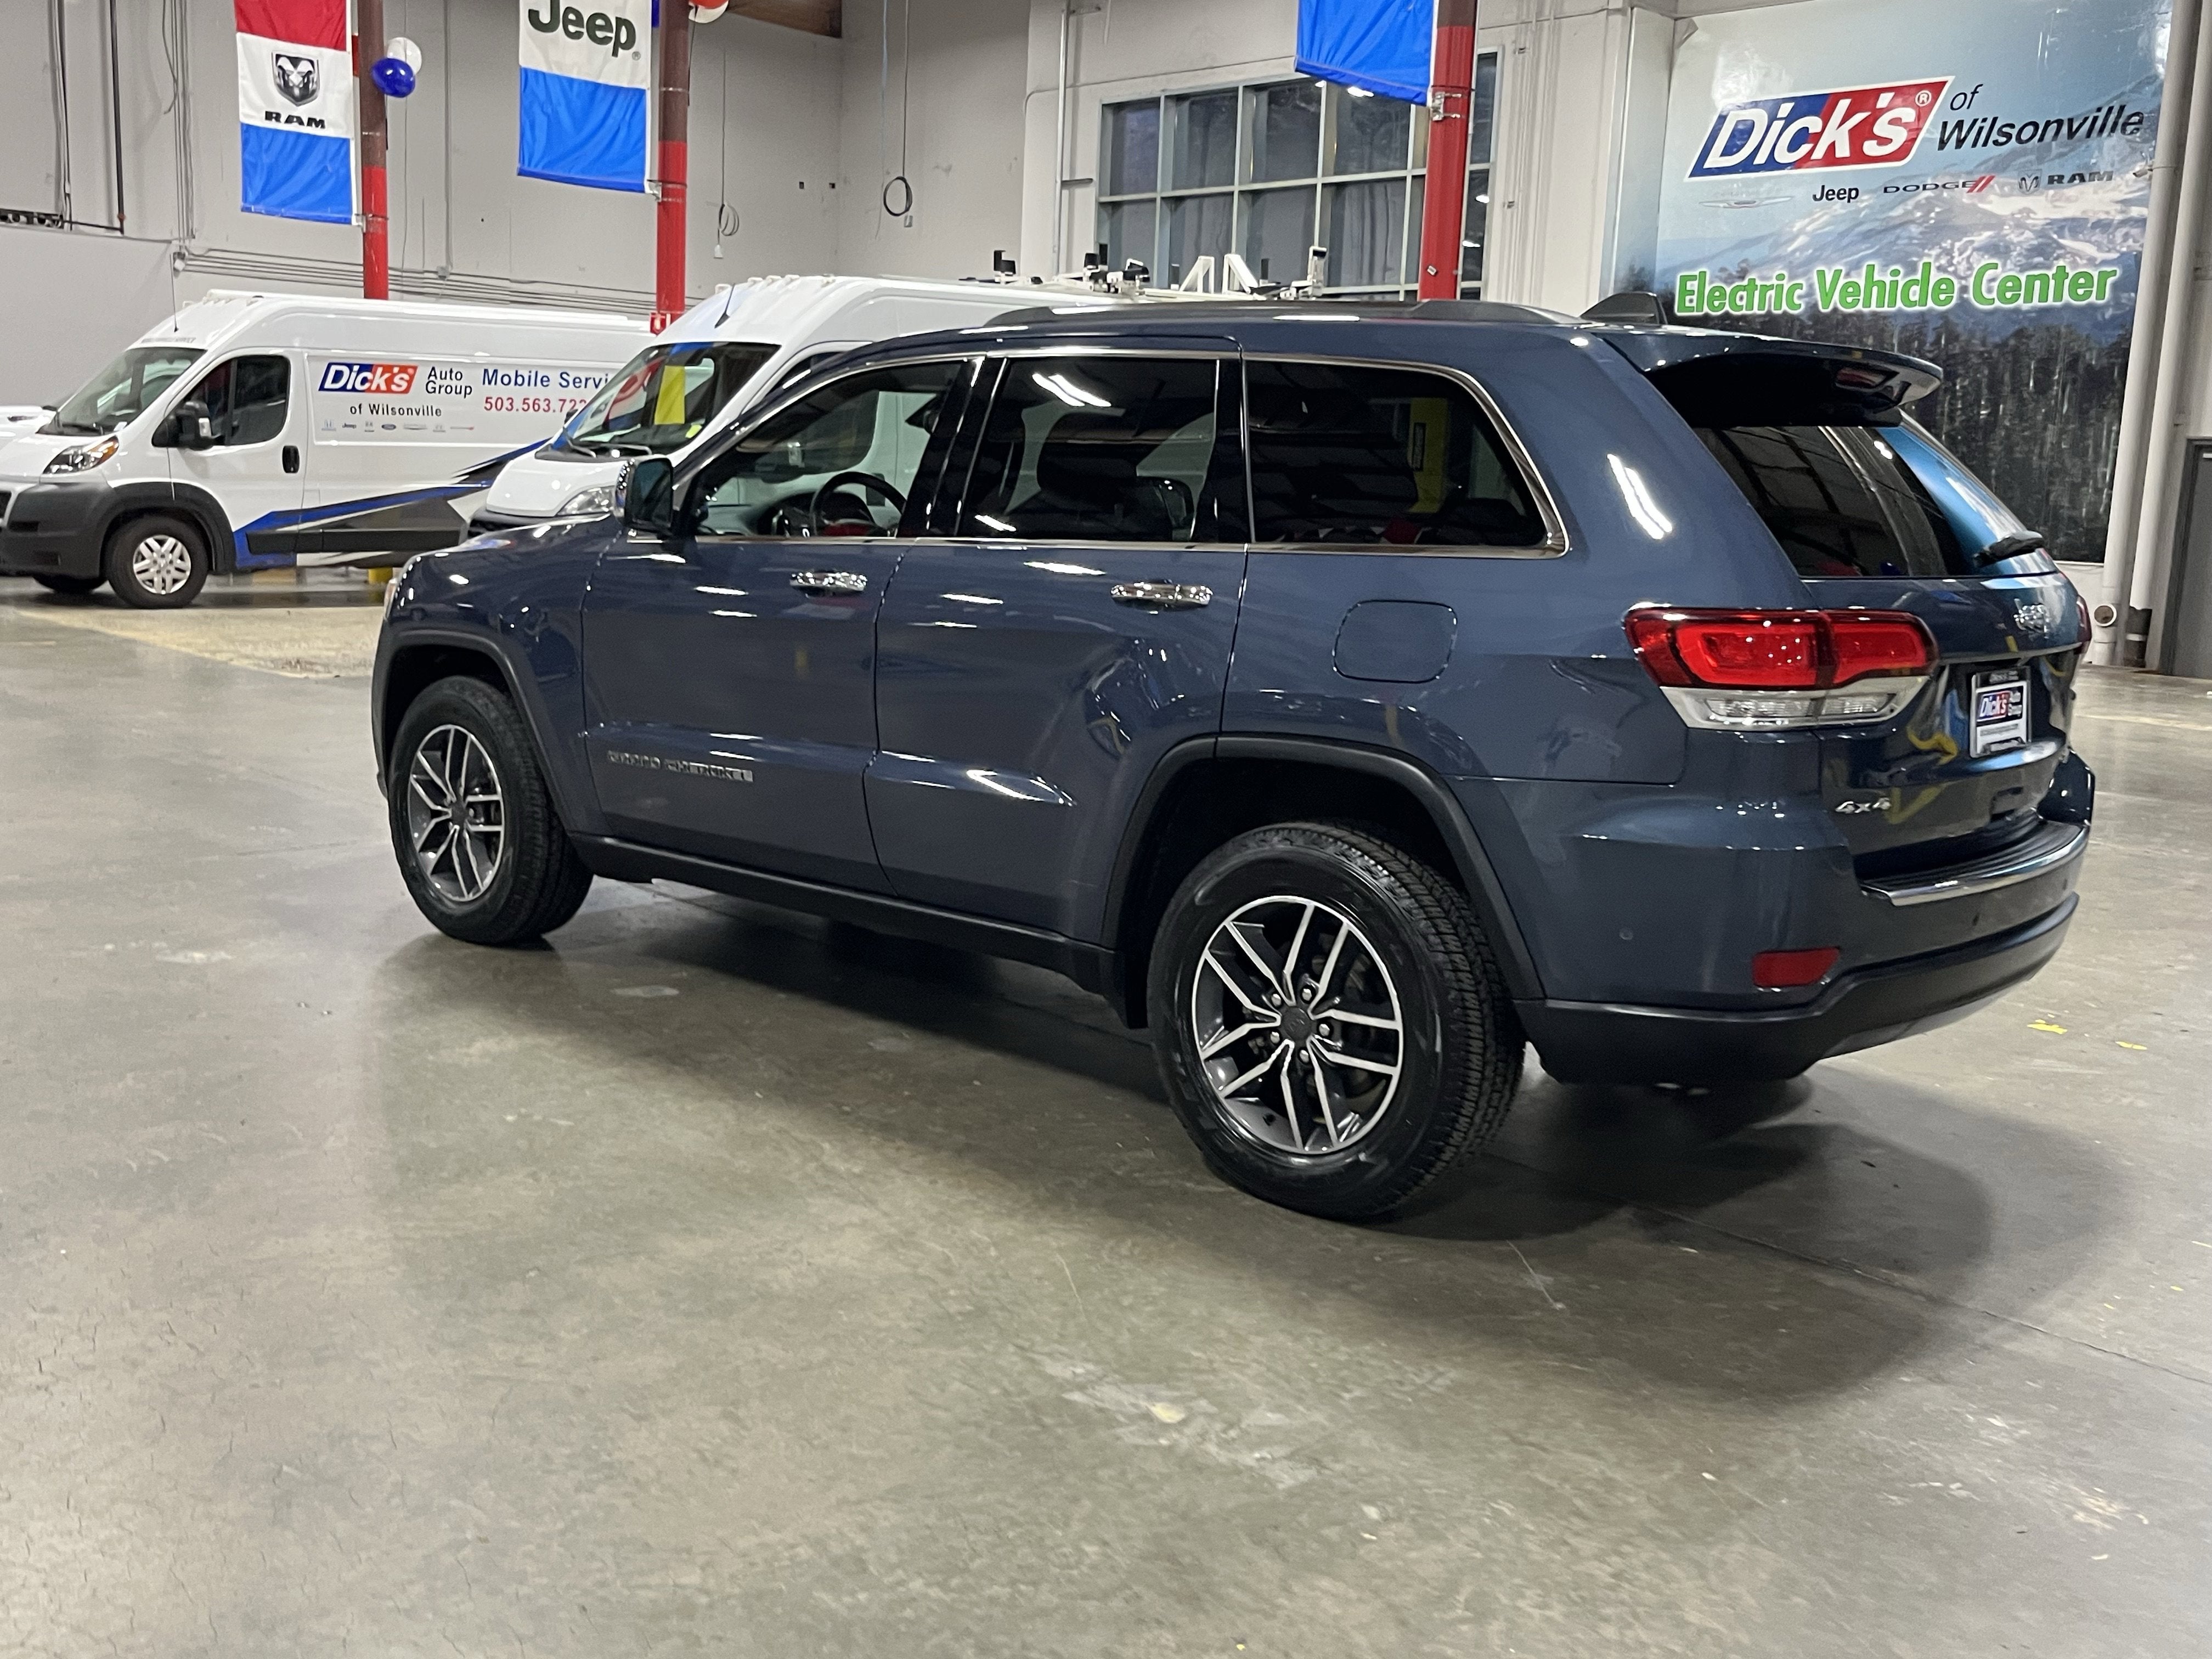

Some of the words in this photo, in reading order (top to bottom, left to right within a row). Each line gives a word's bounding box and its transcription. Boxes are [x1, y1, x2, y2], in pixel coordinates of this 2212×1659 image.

[528, 0, 636, 58] Jeep
[1950, 83, 1984, 111] of
[264, 111, 326, 129] RAM
[1937, 104, 2145, 151] Wilsonville
[1812, 184, 1859, 204] Jeep
[1883, 180, 1976, 194] DODGE
[2047, 170, 2114, 186] RAM
[1677, 270, 1804, 313] Electric
[1816, 261, 1955, 310] Vehicle
[1973, 262, 2117, 306] Center
[427, 366, 463, 381] Auto
[482, 368, 551, 387] Mobile
[425, 380, 472, 399] Group
[350, 403, 363, 415] of
[369, 403, 442, 417] Wilsonville
